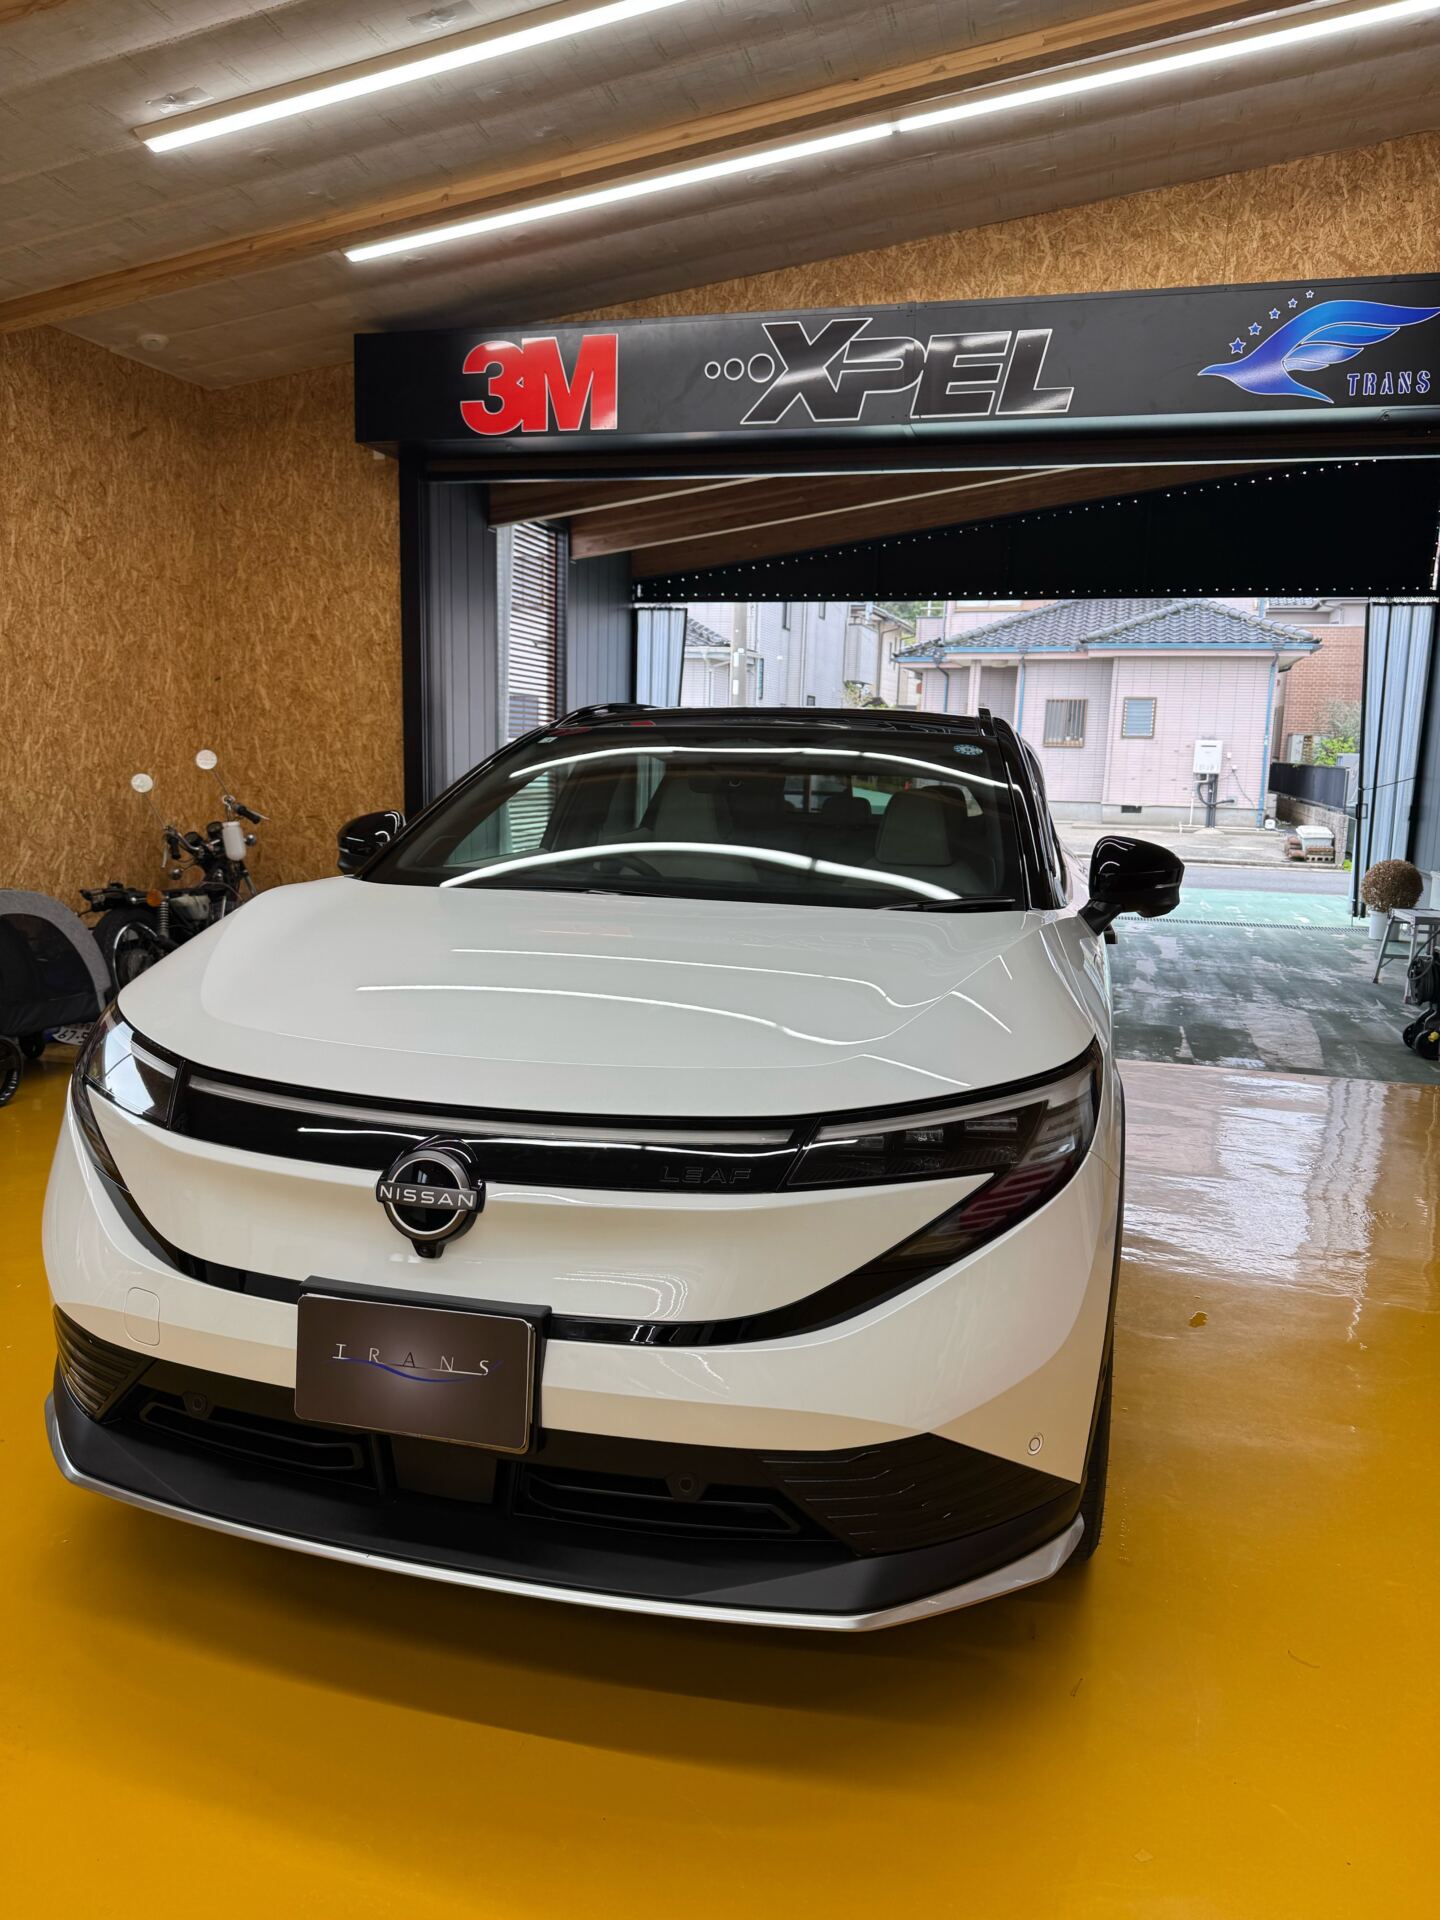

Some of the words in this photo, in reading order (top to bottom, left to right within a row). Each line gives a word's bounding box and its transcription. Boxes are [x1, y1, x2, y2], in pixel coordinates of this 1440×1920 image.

[461, 334, 618, 435] 3M
[740, 318, 1074, 424] XPEL
[1347, 371, 1431, 396] TRANS
[660, 1166, 752, 1184] LEAF
[379, 1184, 475, 1208] NISSAN
[332, 1343, 490, 1376] TRANS
